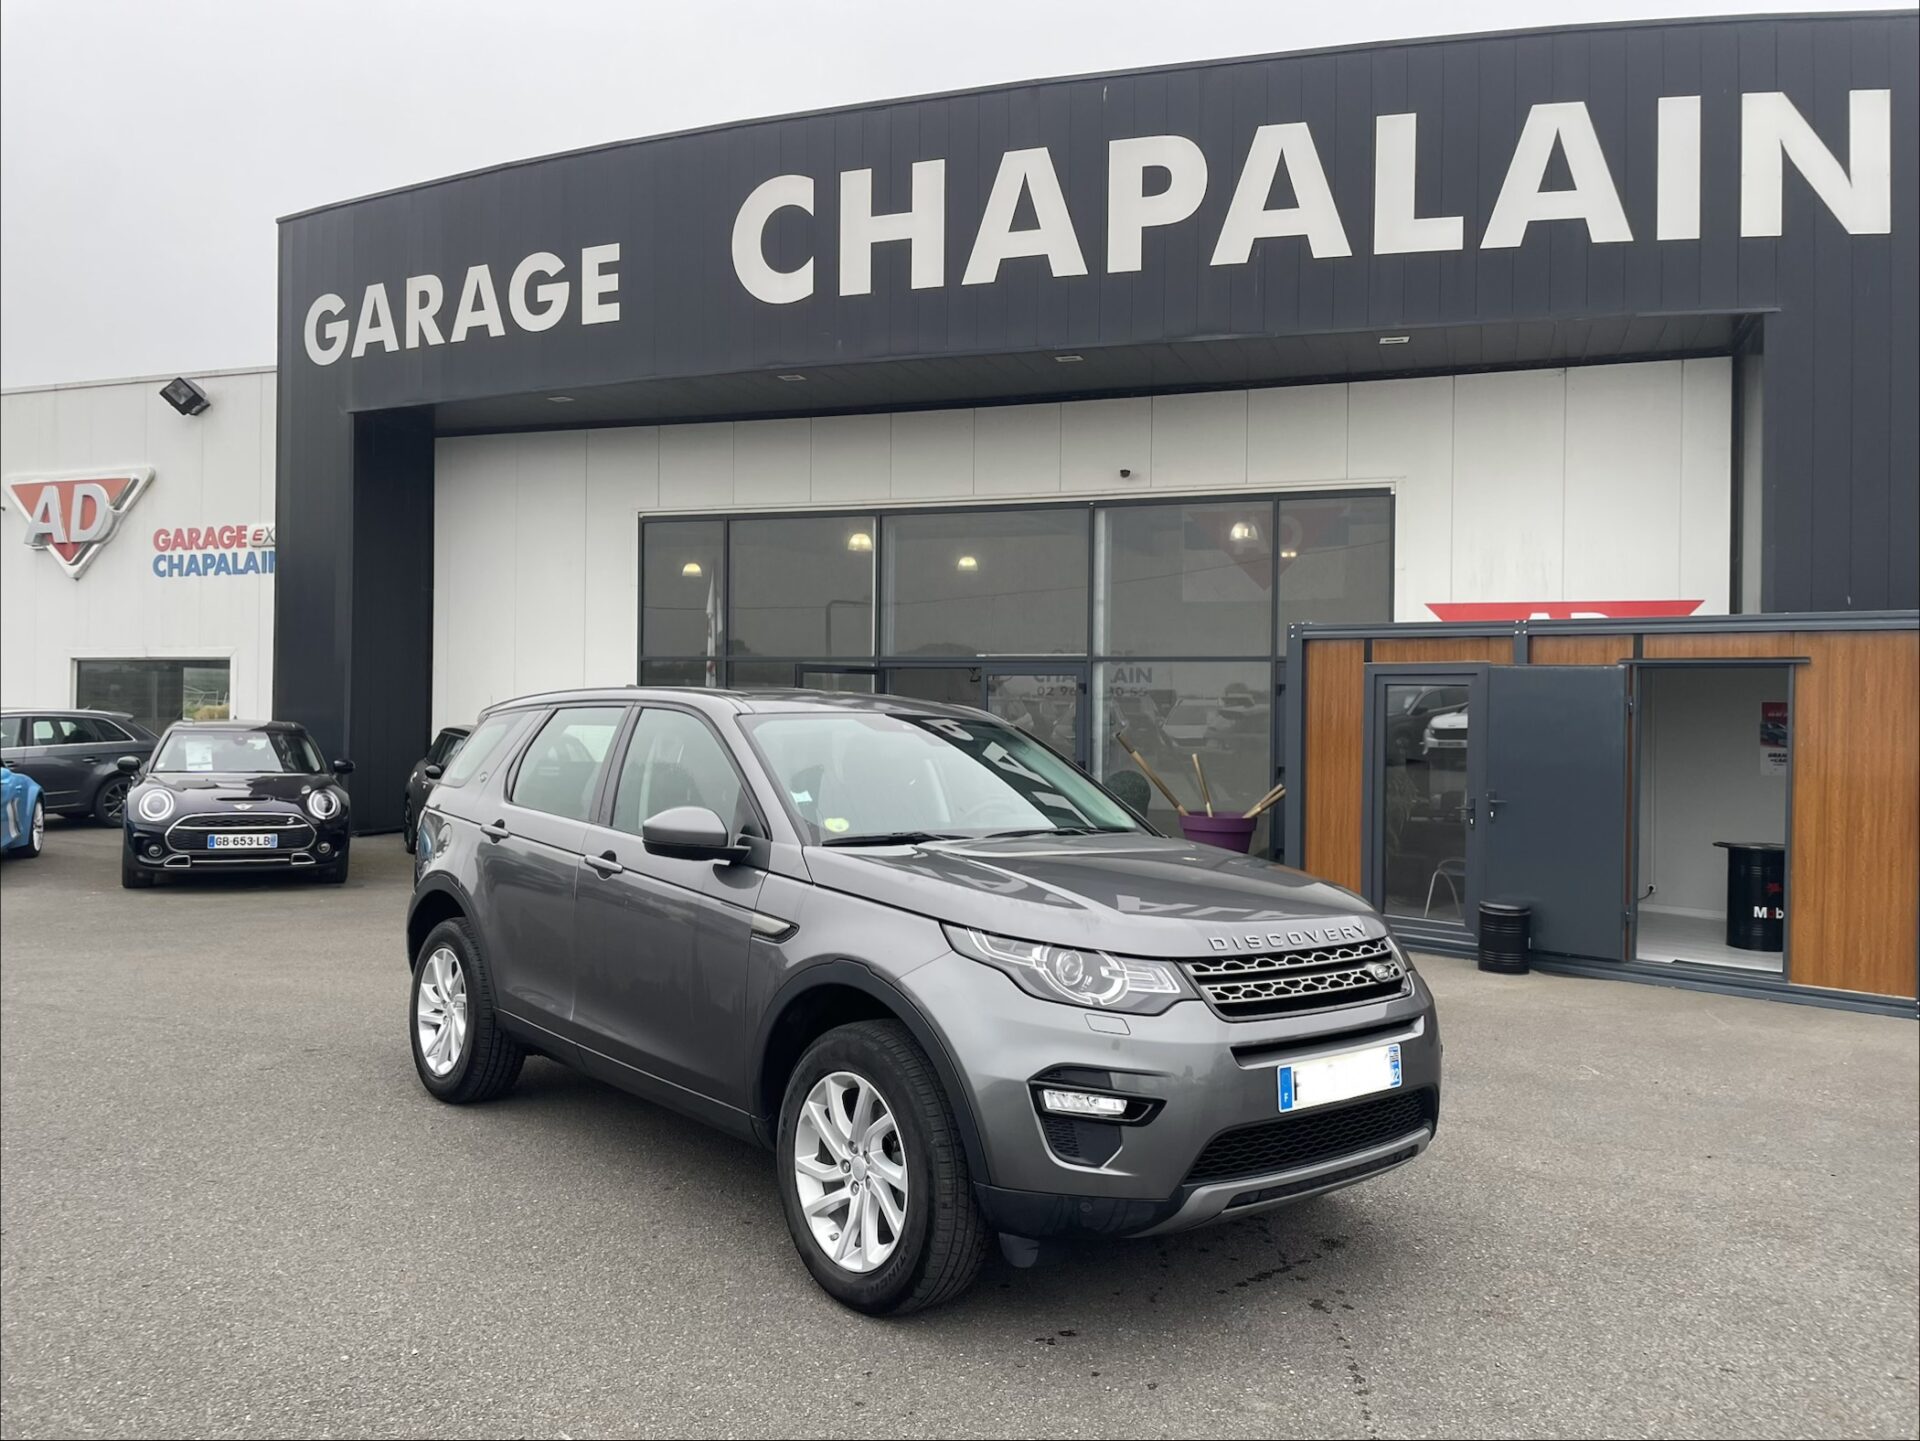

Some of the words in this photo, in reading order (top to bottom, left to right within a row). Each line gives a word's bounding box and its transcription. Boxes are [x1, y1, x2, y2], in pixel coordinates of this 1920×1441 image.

[303, 243, 620, 367] GARAGE
[731, 88, 1891, 305] CHAPALAIN
[24, 483, 112, 546] AD
[152, 525, 248, 552] GARAGE
[1208, 923, 1367, 951] DISCOVERY
